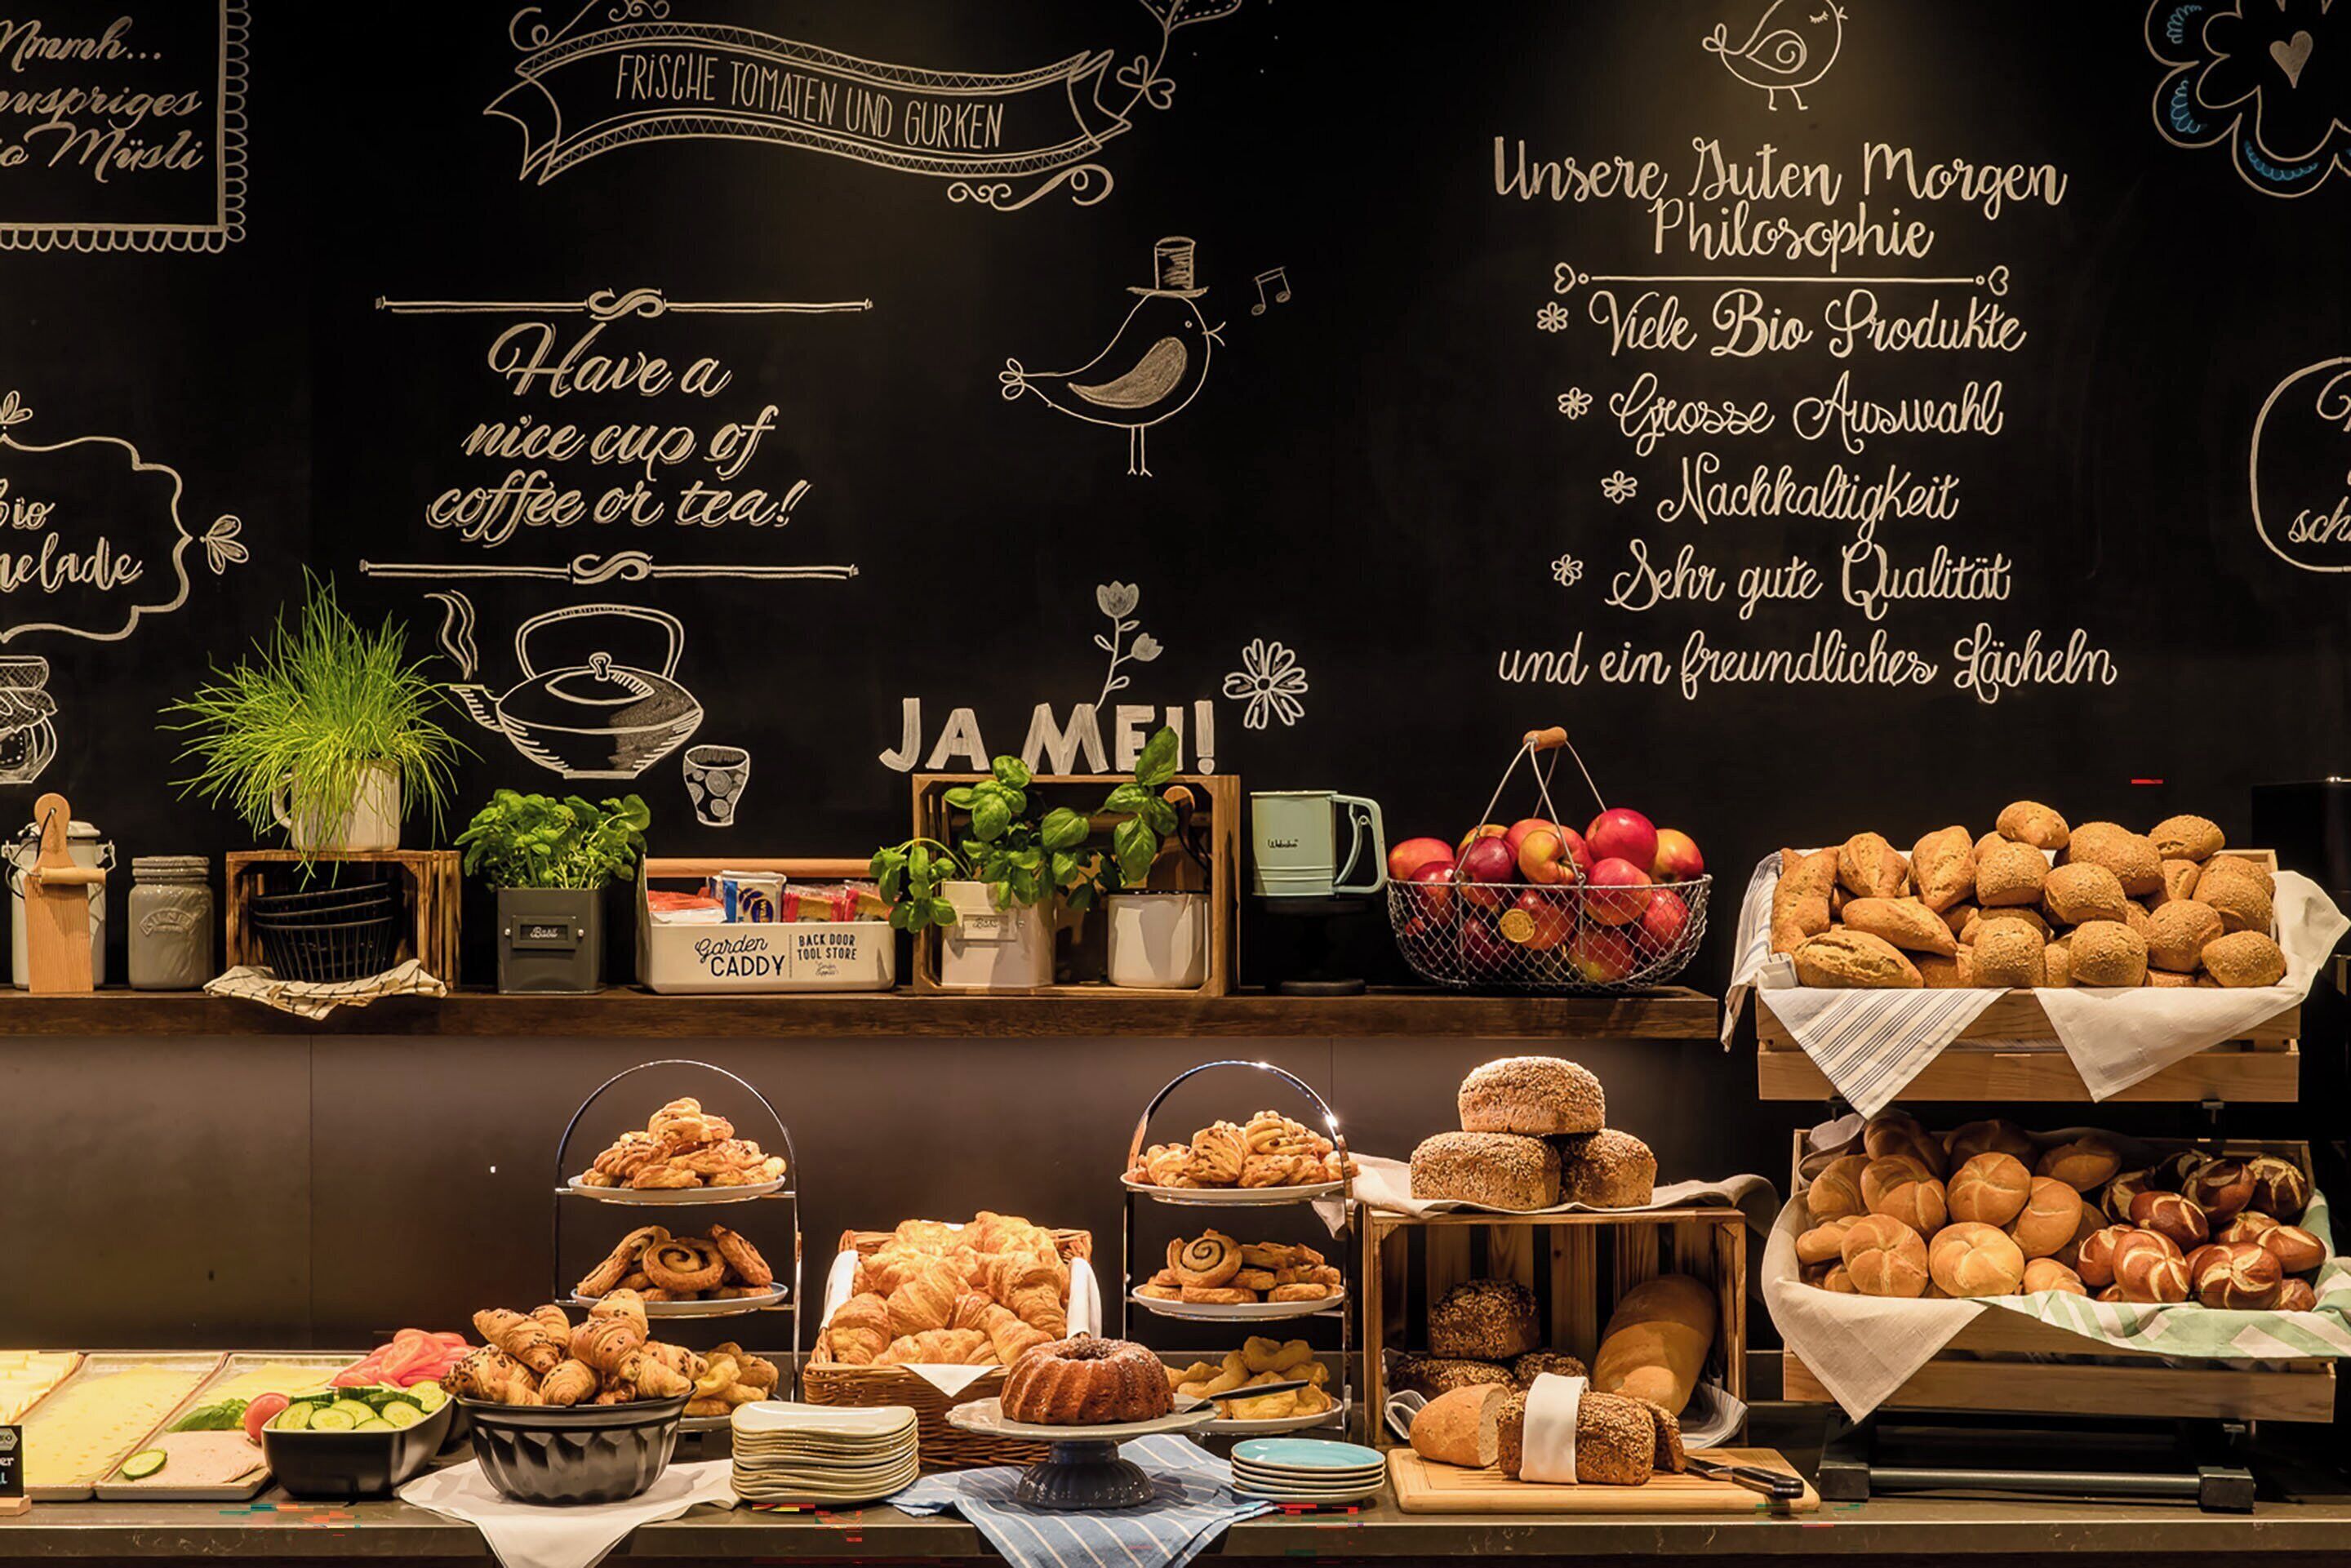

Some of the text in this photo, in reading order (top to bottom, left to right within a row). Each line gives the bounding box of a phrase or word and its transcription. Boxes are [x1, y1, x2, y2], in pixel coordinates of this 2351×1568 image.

[731, 61, 838, 125] TOMATEN
[846, 87, 892, 138] UND
[904, 100, 1004, 149] GURKEN
[23, 121, 204, 183] Müsli
[1494, 135, 1668, 202] Unsere
[1863, 141, 2068, 221] Morgen
[1647, 197, 1935, 273] Philosophie
[487, 321, 733, 399] Have a
[1589, 288, 2027, 358] Viele Bio Produkte
[460, 405, 780, 482] nice cup of
[1609, 369, 2004, 458] Grosse Auswahl
[425, 469, 815, 548] coffee or tea!
[1656, 451, 1960, 542] Nachhaltigkeit
[2288, 495, 2351, 544] sch
[1605, 538, 2011, 620] Sehr gute Qualität
[1498, 632, 1589, 686] und
[1599, 641, 1673, 685] ein
[1678, 629, 1939, 701] freundliches
[879, 698, 1215, 775] JA MEI!
[694, 934, 769, 963] Garden
[710, 955, 785, 977] CADDY
[797, 947, 857, 961] TOOL STORE
[798, 933, 856, 947] BACK DOOR
